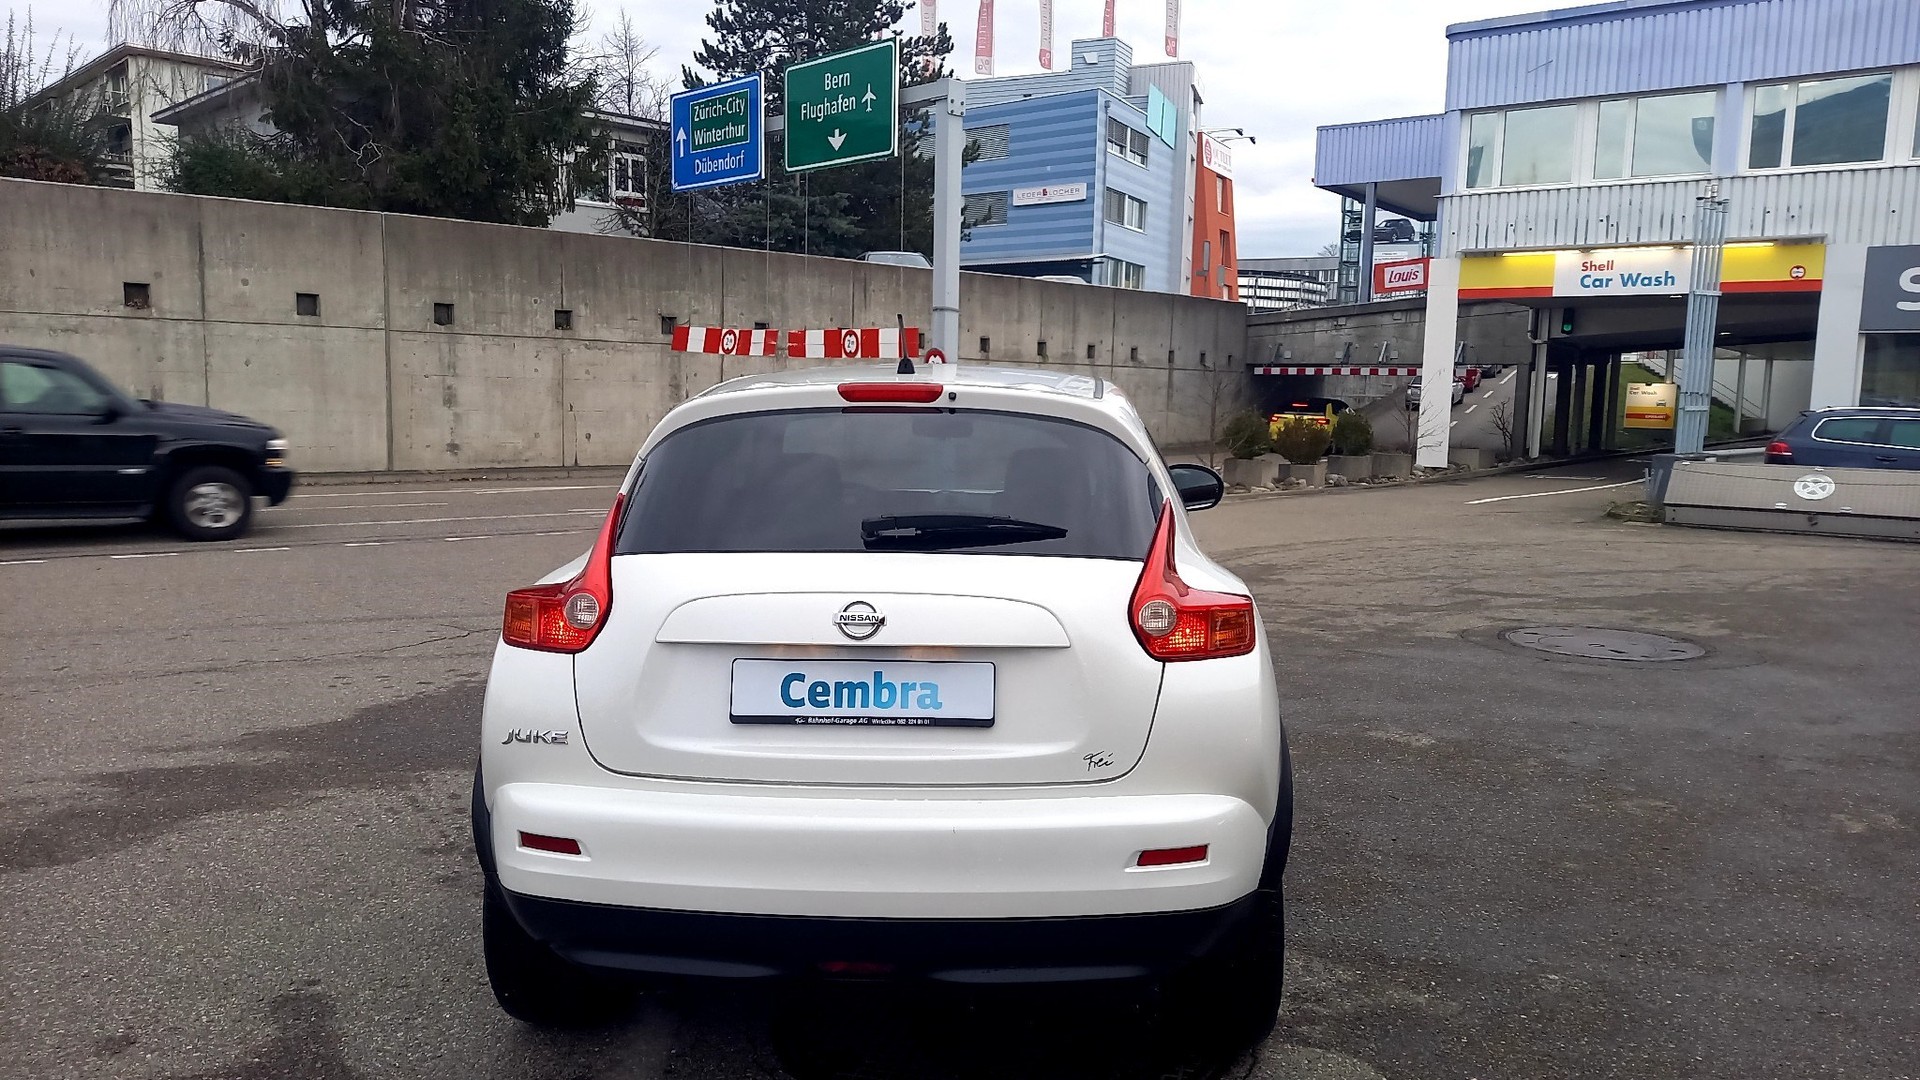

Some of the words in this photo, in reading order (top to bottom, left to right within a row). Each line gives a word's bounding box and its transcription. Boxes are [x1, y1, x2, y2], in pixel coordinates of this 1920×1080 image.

[824, 72, 850, 90] Bern
[694, 96, 745, 122] Zürich-City
[801, 93, 856, 122] Flughafen
[694, 121, 746, 146] Winterthur
[694, 149, 745, 175] Dübendorf
[1581, 260, 1614, 272] Shell
[1388, 268, 1419, 284] Louis
[1580, 274, 1613, 289] Car
[1619, 270, 1676, 288] Wash
[839, 614, 879, 622] NISSAN
[780, 670, 943, 711] Cembra
[501, 728, 569, 745] JUKE
